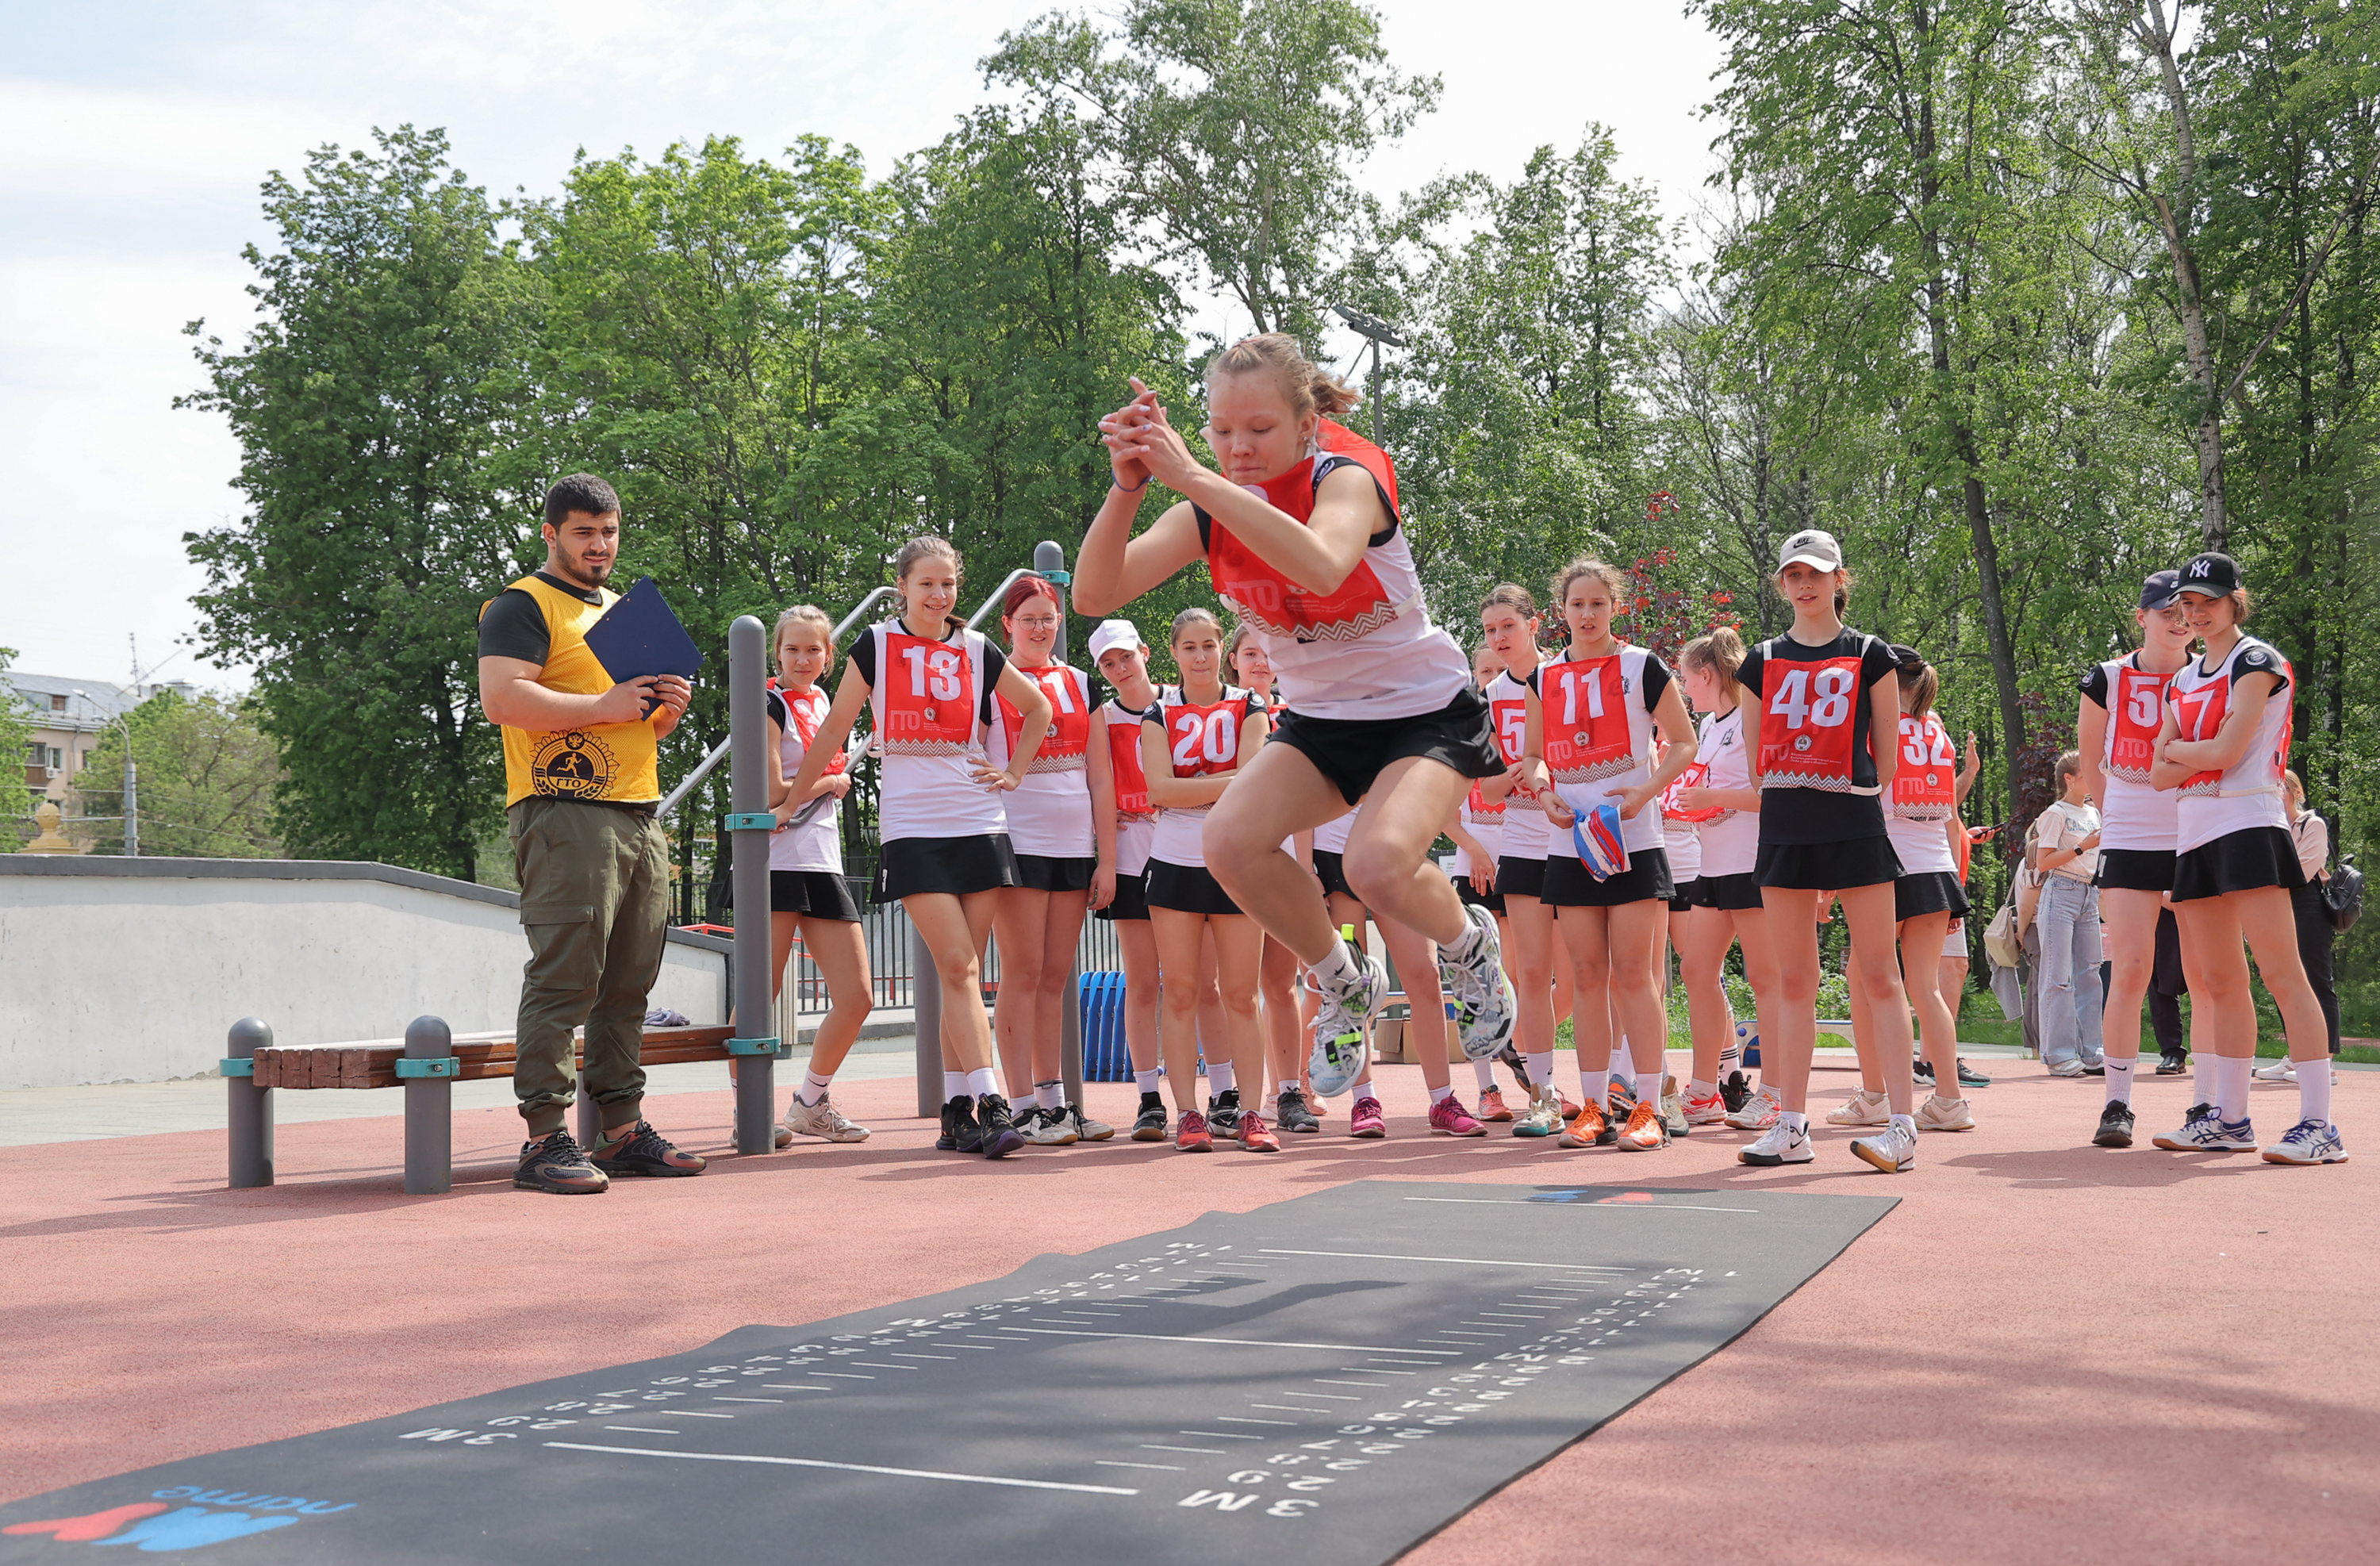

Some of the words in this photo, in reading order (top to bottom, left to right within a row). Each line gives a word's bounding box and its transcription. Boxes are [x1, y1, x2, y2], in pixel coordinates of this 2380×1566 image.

[902, 645, 962, 701] 13
[1560, 667, 1604, 726] 11
[1769, 667, 1855, 729] 48
[890, 710, 920, 731] ГТО
[1173, 709, 1236, 766] 20
[1899, 717, 1952, 767] 32
[1547, 740, 1573, 762] ГТО
[1760, 743, 1791, 766] ГТО
[556, 778, 582, 788] ГТО
[1898, 777, 1925, 795] ГТО
[1449, 1373, 1534, 1386] 2.2
[596, 1388, 687, 1401] 2.7
[1426, 1387, 1514, 1400] 2.3
[544, 1400, 635, 1414] 2.8
[1400, 1399, 1491, 1412] 2.4
[486, 1415, 579, 1430] 2.9
[1367, 1412, 1464, 1426] 2.5
[1338, 1425, 1433, 1439] 2.6
[1299, 1439, 1404, 1455] 2.7
[1266, 1453, 1371, 1471] 2.8
[1227, 1469, 1336, 1491] 2.9
